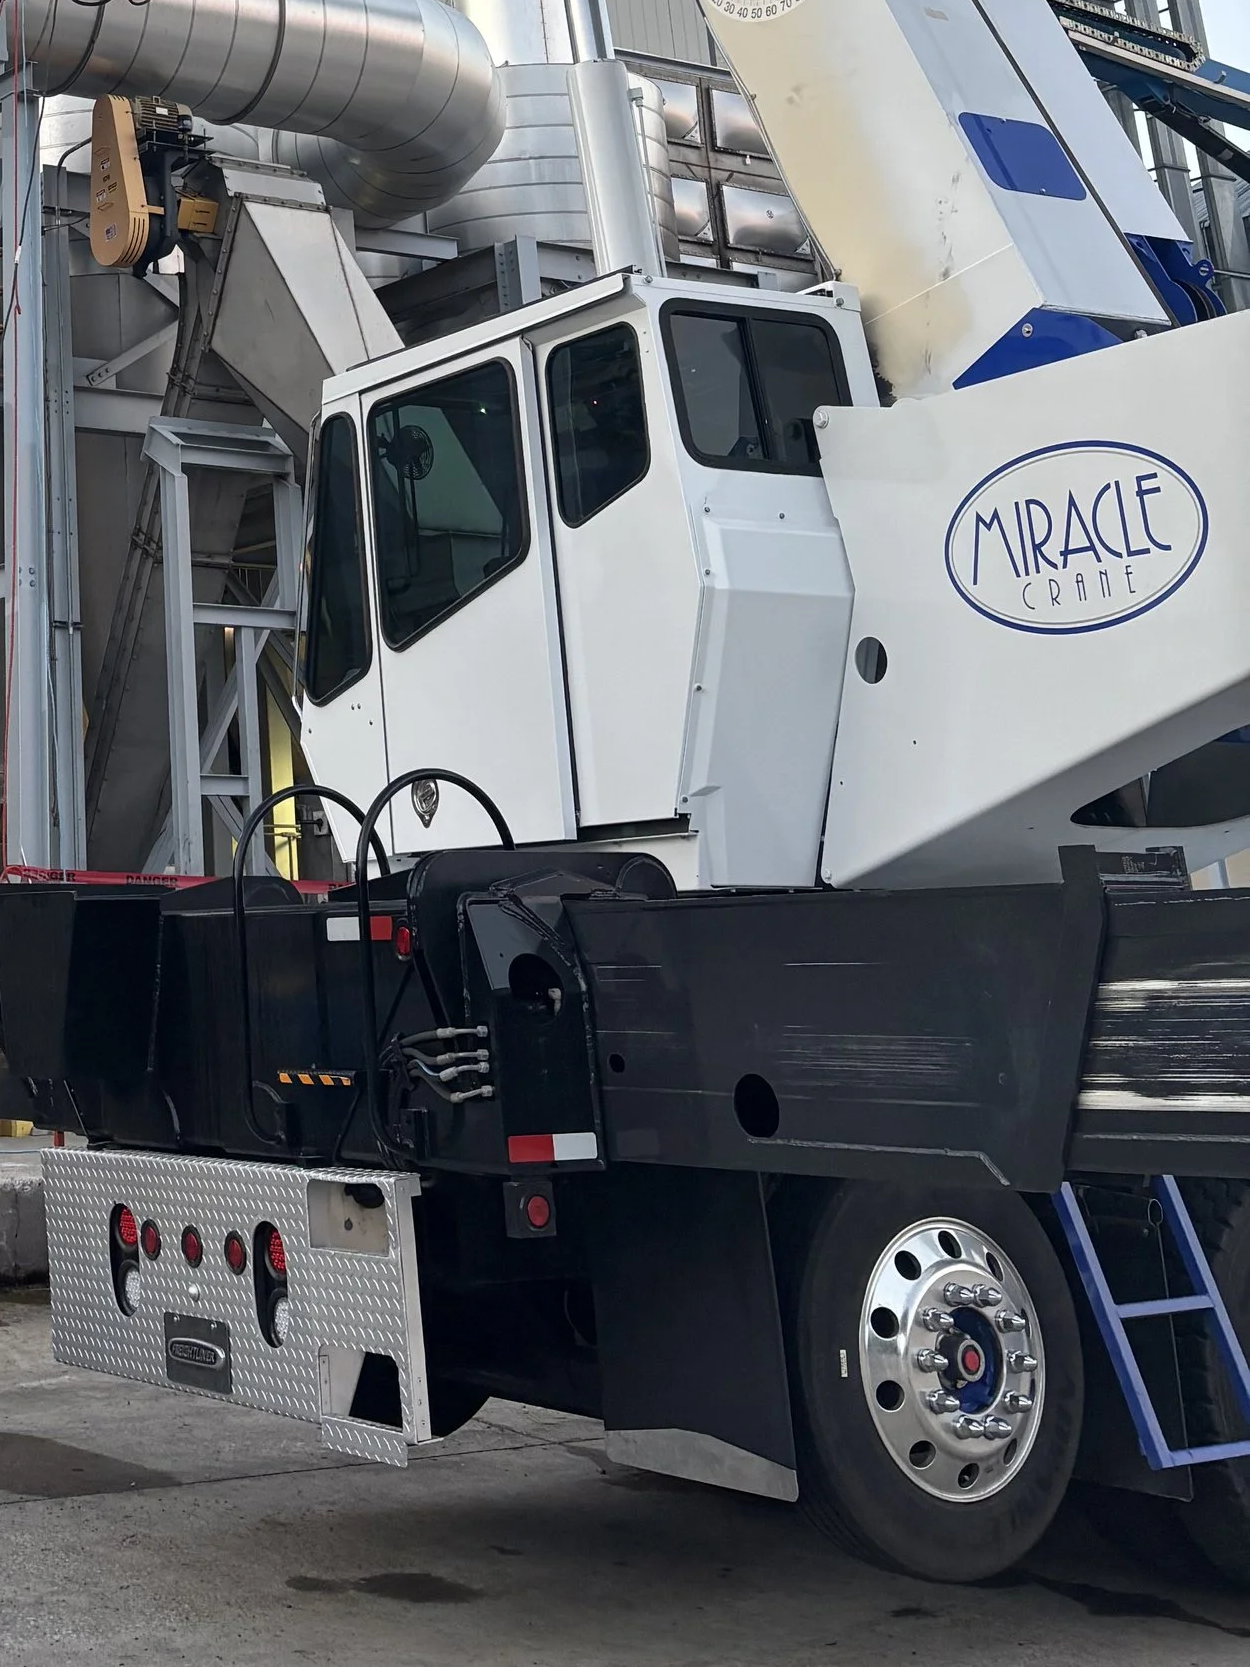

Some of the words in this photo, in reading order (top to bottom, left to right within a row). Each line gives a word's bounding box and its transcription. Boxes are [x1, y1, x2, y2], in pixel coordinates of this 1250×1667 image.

[724, 2, 735, 14] 30
[737, 7, 748, 18] 40
[751, 8, 762, 19] 50
[766, 5, 777, 16] 60
[973, 472, 1172, 586] MIRACLE
[1022, 565, 1136, 610] CRANE
